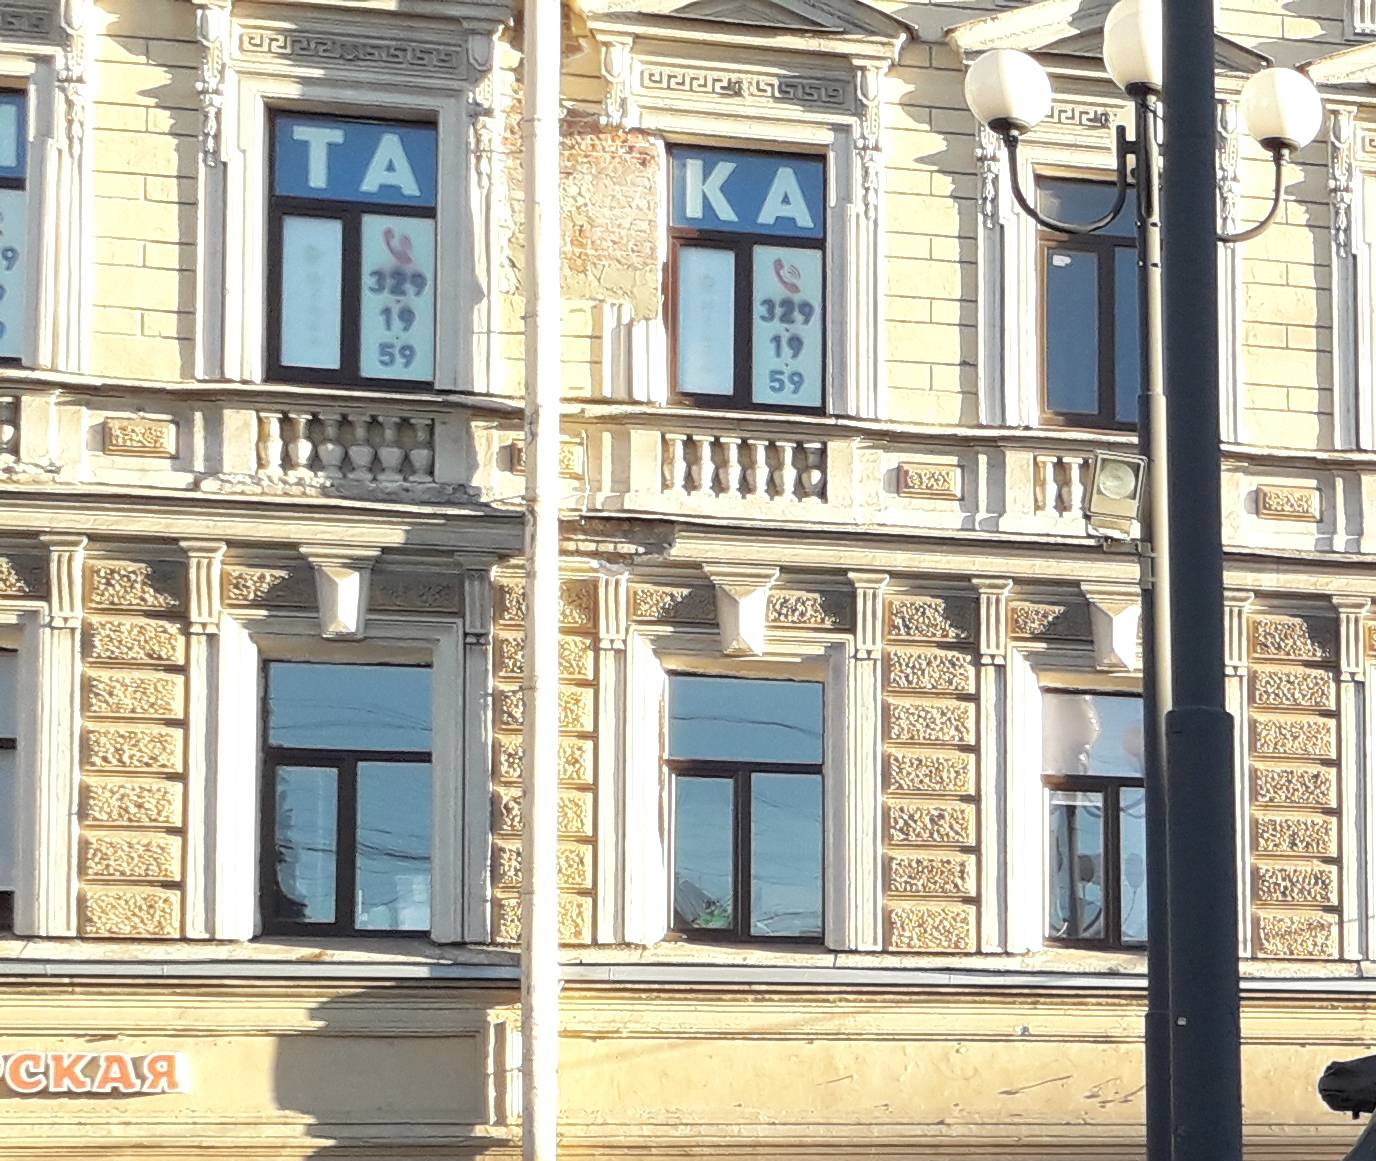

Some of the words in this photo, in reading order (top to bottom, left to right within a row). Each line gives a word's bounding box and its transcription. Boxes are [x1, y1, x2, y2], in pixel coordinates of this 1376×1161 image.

[291, 125, 423, 197] ТА
[684, 157, 817, 229] КА
[368, 268, 428, 298] 329
[379, 304, 414, 333] 19
[759, 296, 815, 325] 329
[377, 340, 417, 369] 59
[769, 333, 804, 361] 19
[767, 368, 804, 395] 59
[0, 1052, 184, 1093] СКАЯ
